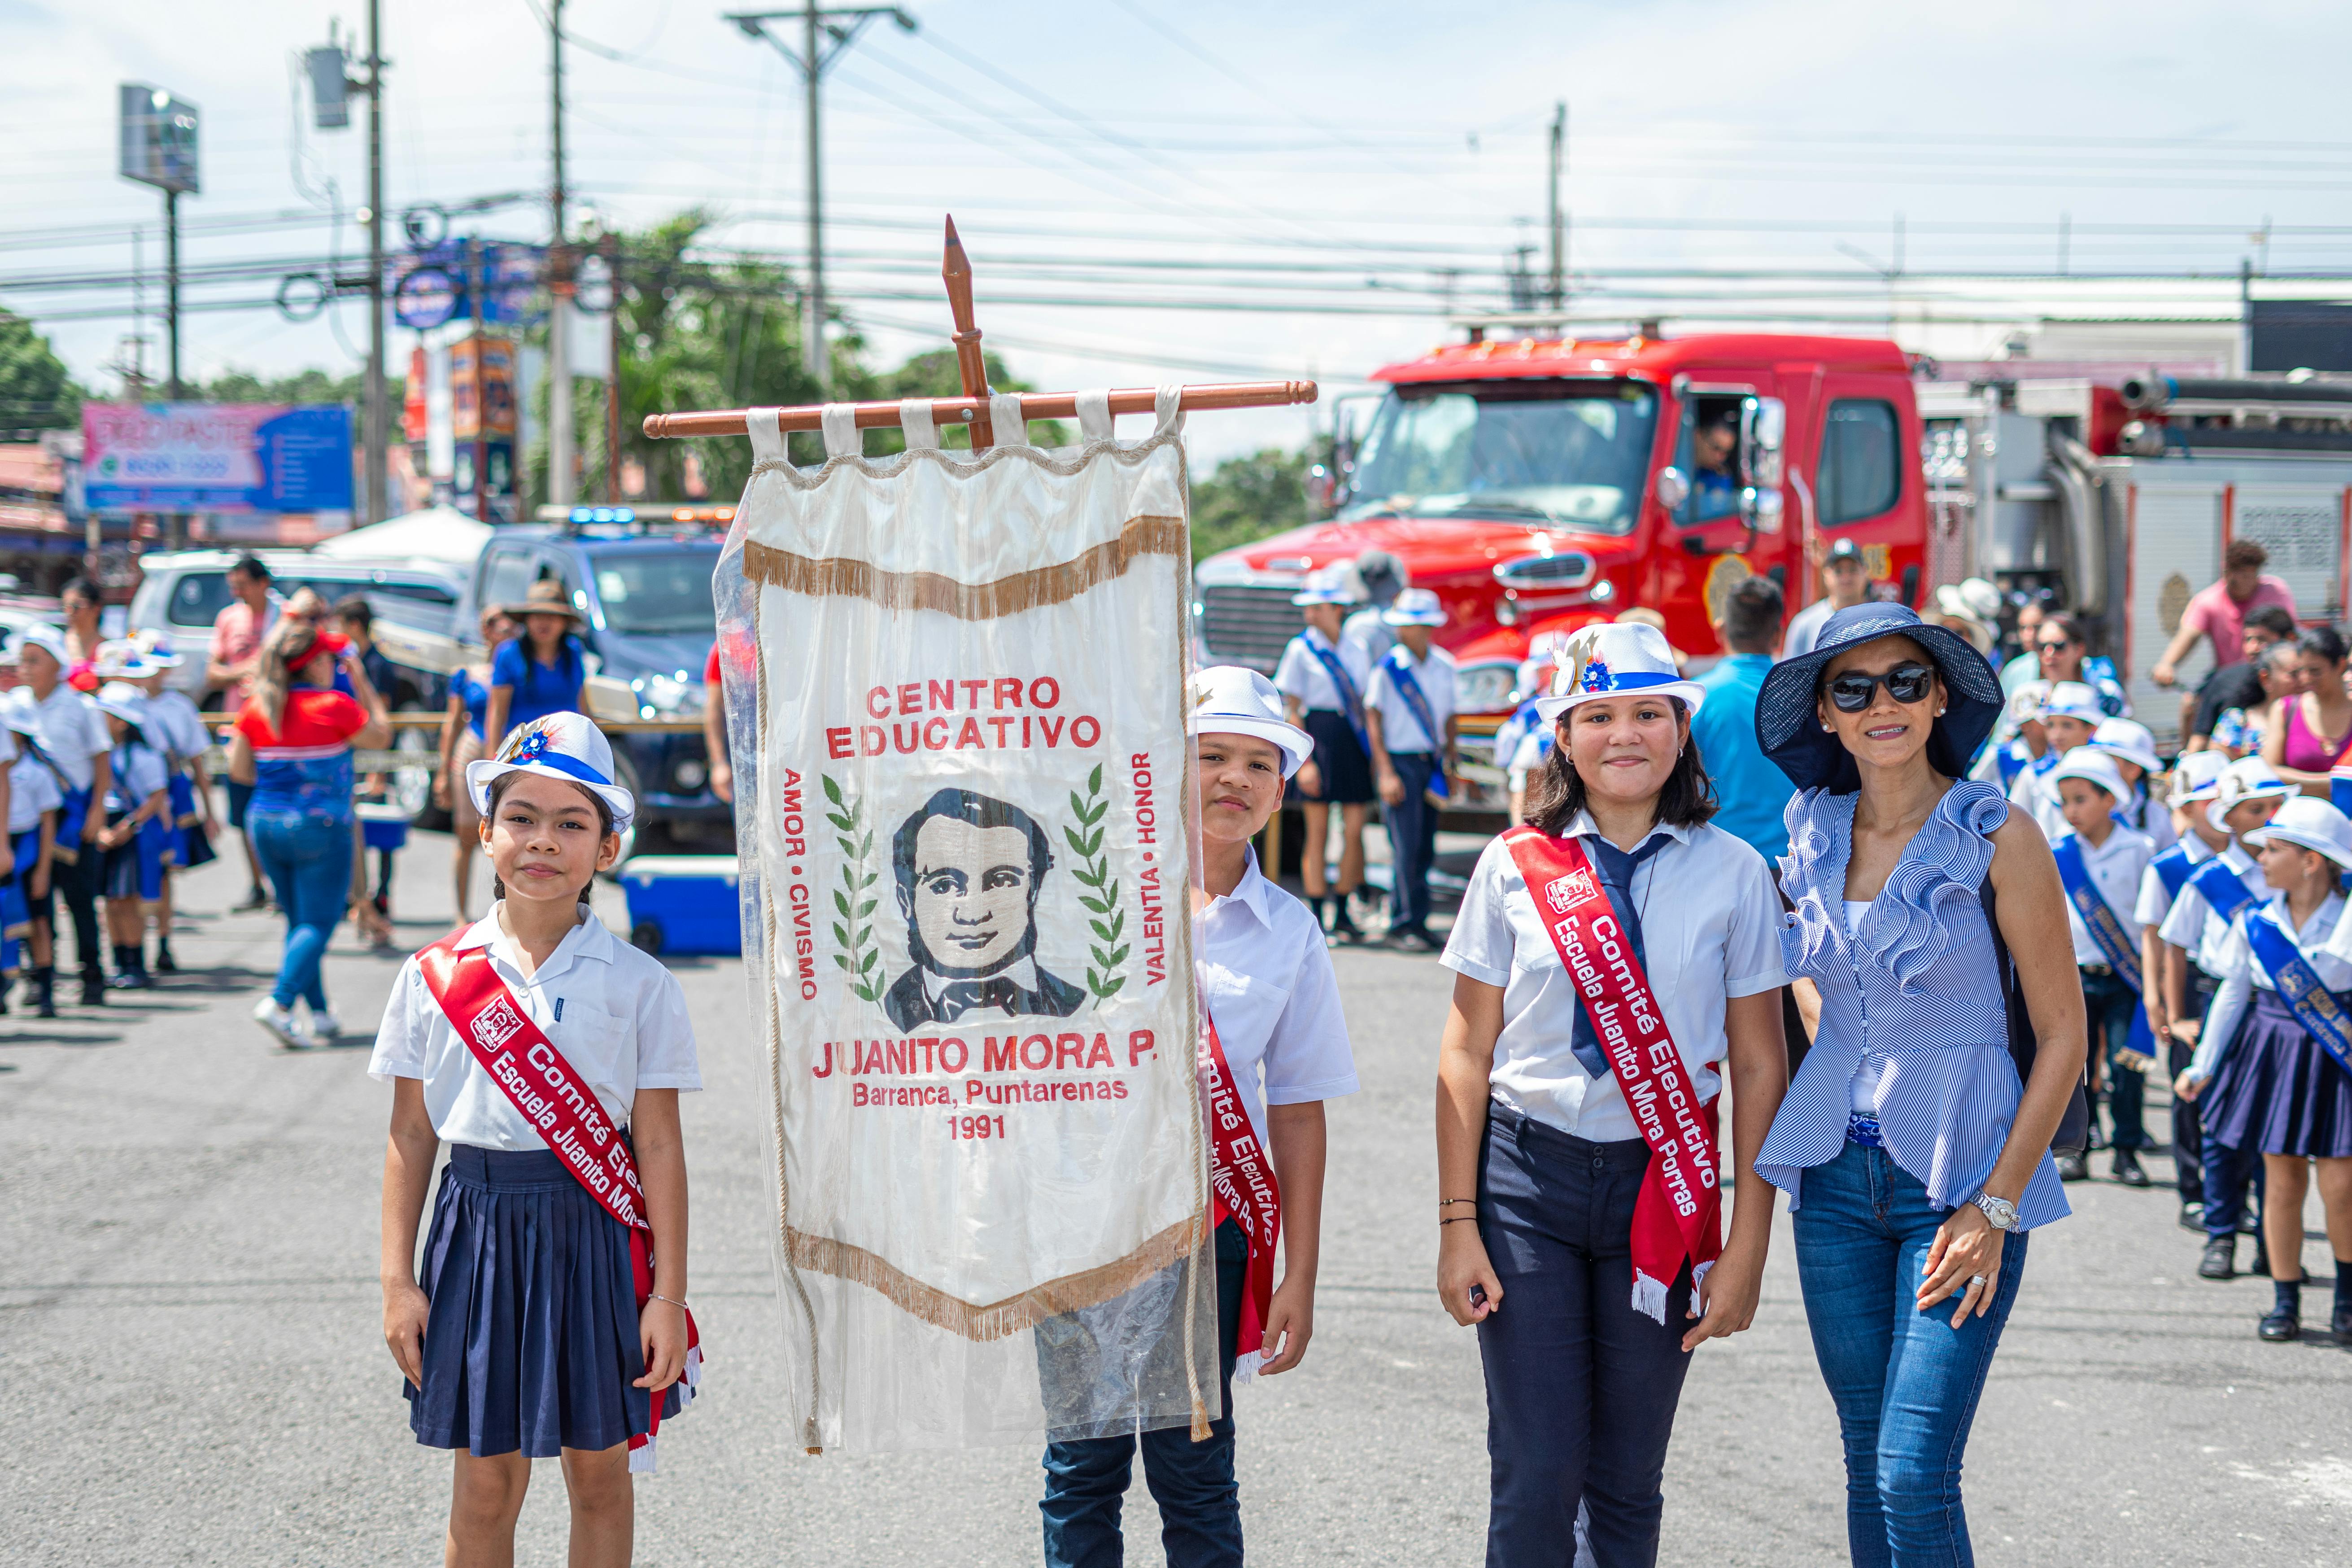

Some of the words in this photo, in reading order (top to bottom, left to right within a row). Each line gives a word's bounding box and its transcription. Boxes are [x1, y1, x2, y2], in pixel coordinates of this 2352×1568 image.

[826, 716, 1101, 760] EDUCATIVO
[867, 676, 1060, 719] CENTRO
[784, 768, 806, 857] AMOR
[1131, 751, 1156, 844] HONOR
[789, 883, 817, 1000] CIVISMO
[1141, 867, 1166, 986] VALENTIA
[527, 1043, 611, 1146] Comité
[812, 1037, 969, 1079] JUANITO
[984, 1033, 1114, 1072] MORA
[1129, 1029, 1157, 1066] P.
[853, 1083, 958, 1109] Barranca,
[966, 1079, 1128, 1105] Puntarenas
[1554, 915, 1604, 998] Escuela
[1594, 1000, 1640, 1079] Juanito
[1629, 1079, 1664, 1141] Mora
[1658, 1138, 1697, 1217] Porras
[1592, 915, 1659, 1035] Comité
[1648, 1039, 1715, 1189] Ejecutivo
[491, 1050, 557, 1130] Escuela
[552, 1126, 610, 1194] Juanito
[607, 1183, 650, 1230] Mora
[947, 1114, 1005, 1140] 1991
[1213, 1166, 1241, 1211] Mora
[1231, 1135, 1277, 1246] Ejecutivo
